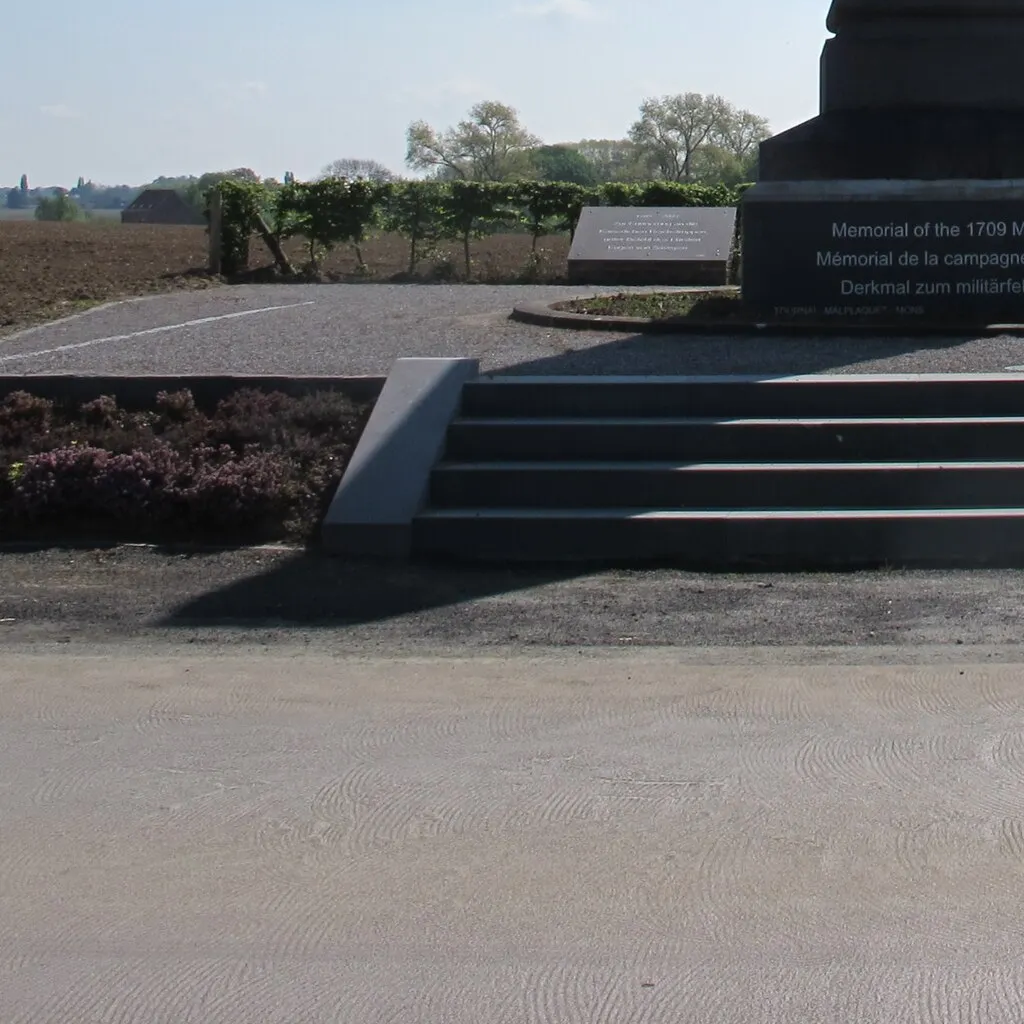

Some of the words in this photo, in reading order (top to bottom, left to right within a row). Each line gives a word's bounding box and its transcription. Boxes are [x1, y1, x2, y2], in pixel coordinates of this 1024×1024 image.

[832, 222, 909, 238] Memorial
[913, 221, 931, 238] of
[934, 222, 961, 237] the
[967, 221, 1007, 237] 1709
[816, 251, 893, 267] Mémorial
[898, 251, 919, 266] de
[924, 251, 939, 266] la
[841, 279, 910, 295] Derkmal
[915, 282, 951, 295] zum
